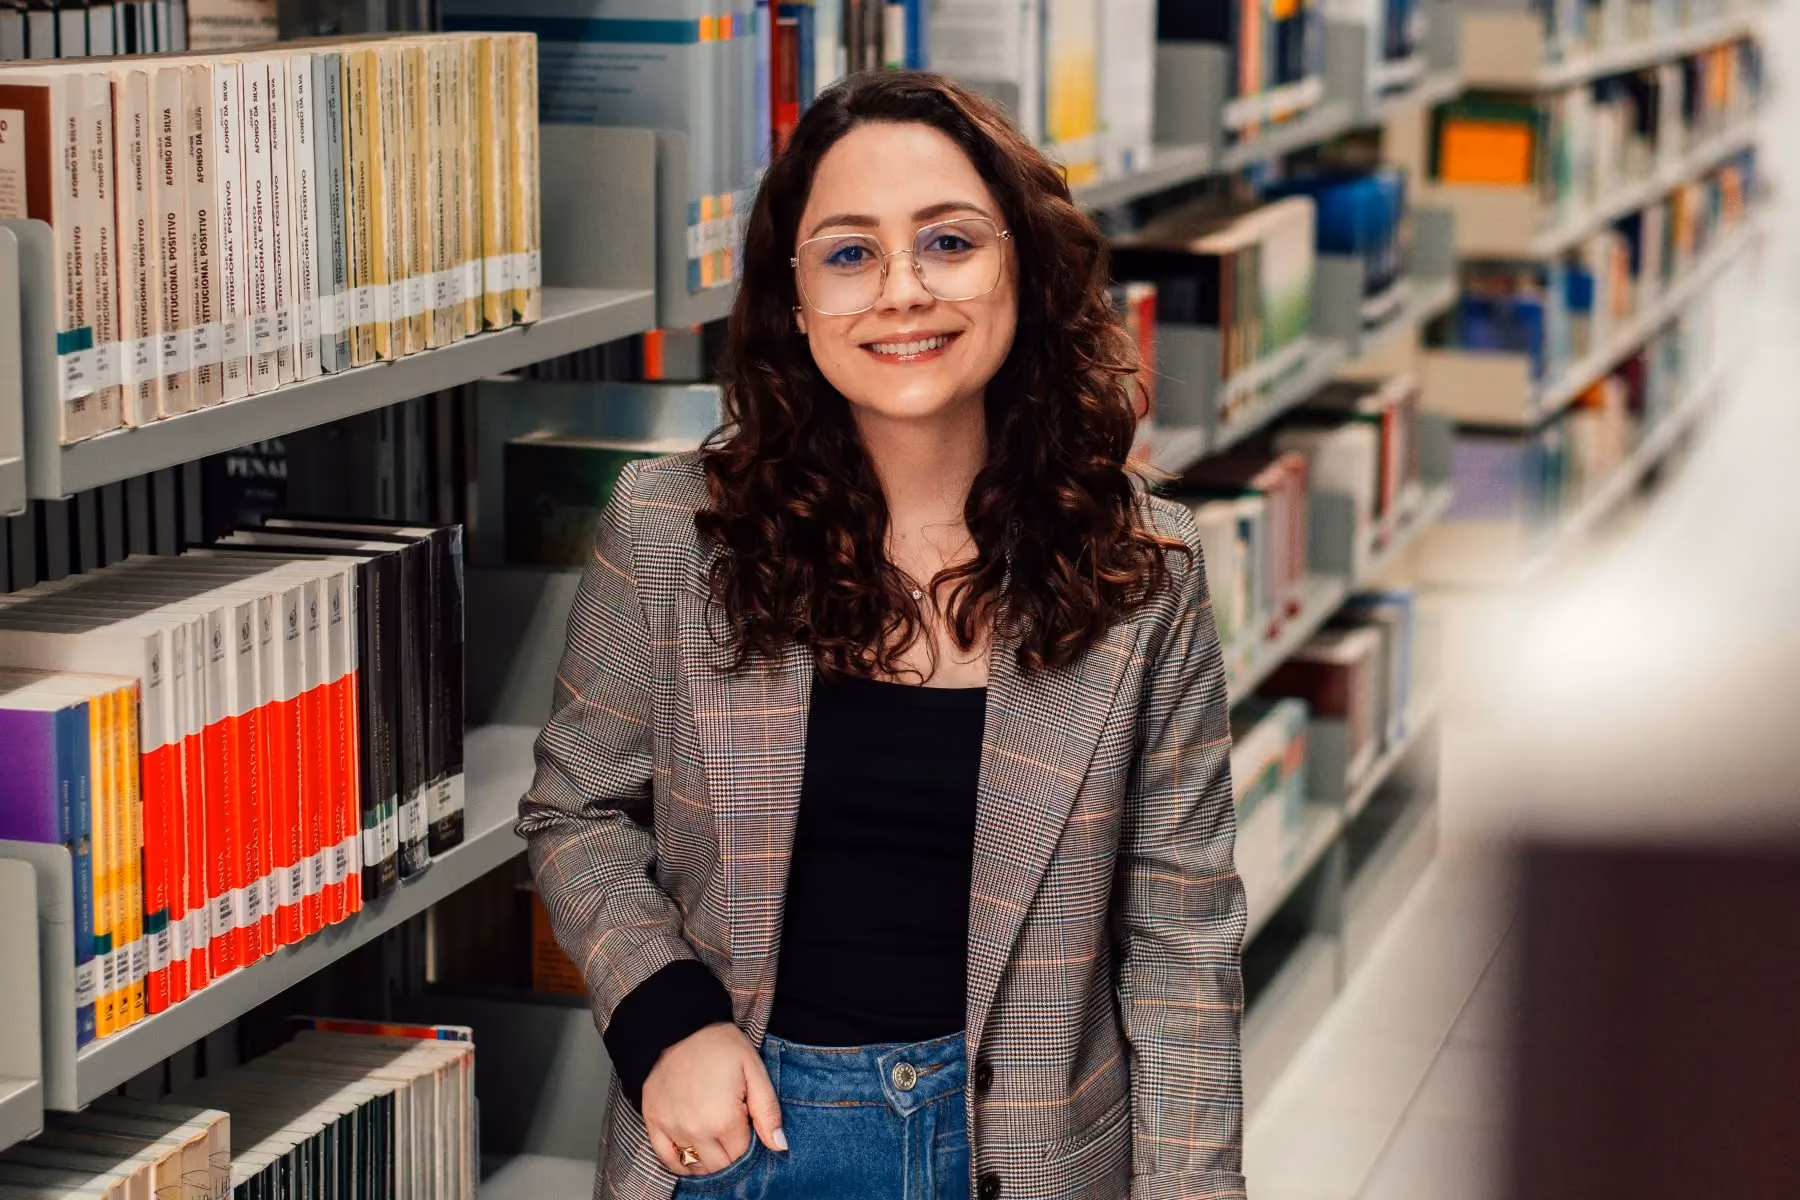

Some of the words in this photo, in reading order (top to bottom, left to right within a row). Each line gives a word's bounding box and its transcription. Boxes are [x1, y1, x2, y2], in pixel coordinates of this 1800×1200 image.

[69, 117, 77, 142] SILVA
[164, 108, 172, 133] SILVA
[223, 104, 229, 117] DA
[253, 105, 259, 117] DA
[71, 145, 77, 158] DA
[97, 147, 103, 159] DA
[135, 141, 141, 152] DA
[164, 136, 172, 147] DA
[195, 133, 202, 145] DA
[165, 150, 173, 186] AFONSO
[196, 148, 204, 183] AFONSO
[225, 180, 233, 234] POSITIVO
[255, 179, 264, 232] POSITIVO
[301, 168, 310, 220] POSITIVO
[74, 226, 84, 276] POSITIVO
[100, 228, 109, 276] POSITIVO
[138, 219, 146, 266] POSITIVO
[167, 213, 177, 260] POSITIVO
[199, 209, 208, 256] POSITIVO
[200, 260, 210, 324] STITUCIONAL
[227, 238, 236, 313] STITUCIONAL
[258, 238, 267, 312] STITUCIONAL
[139, 270, 149, 338] STITUCIONAL
[249, 712, 258, 806] CIDADANIA
